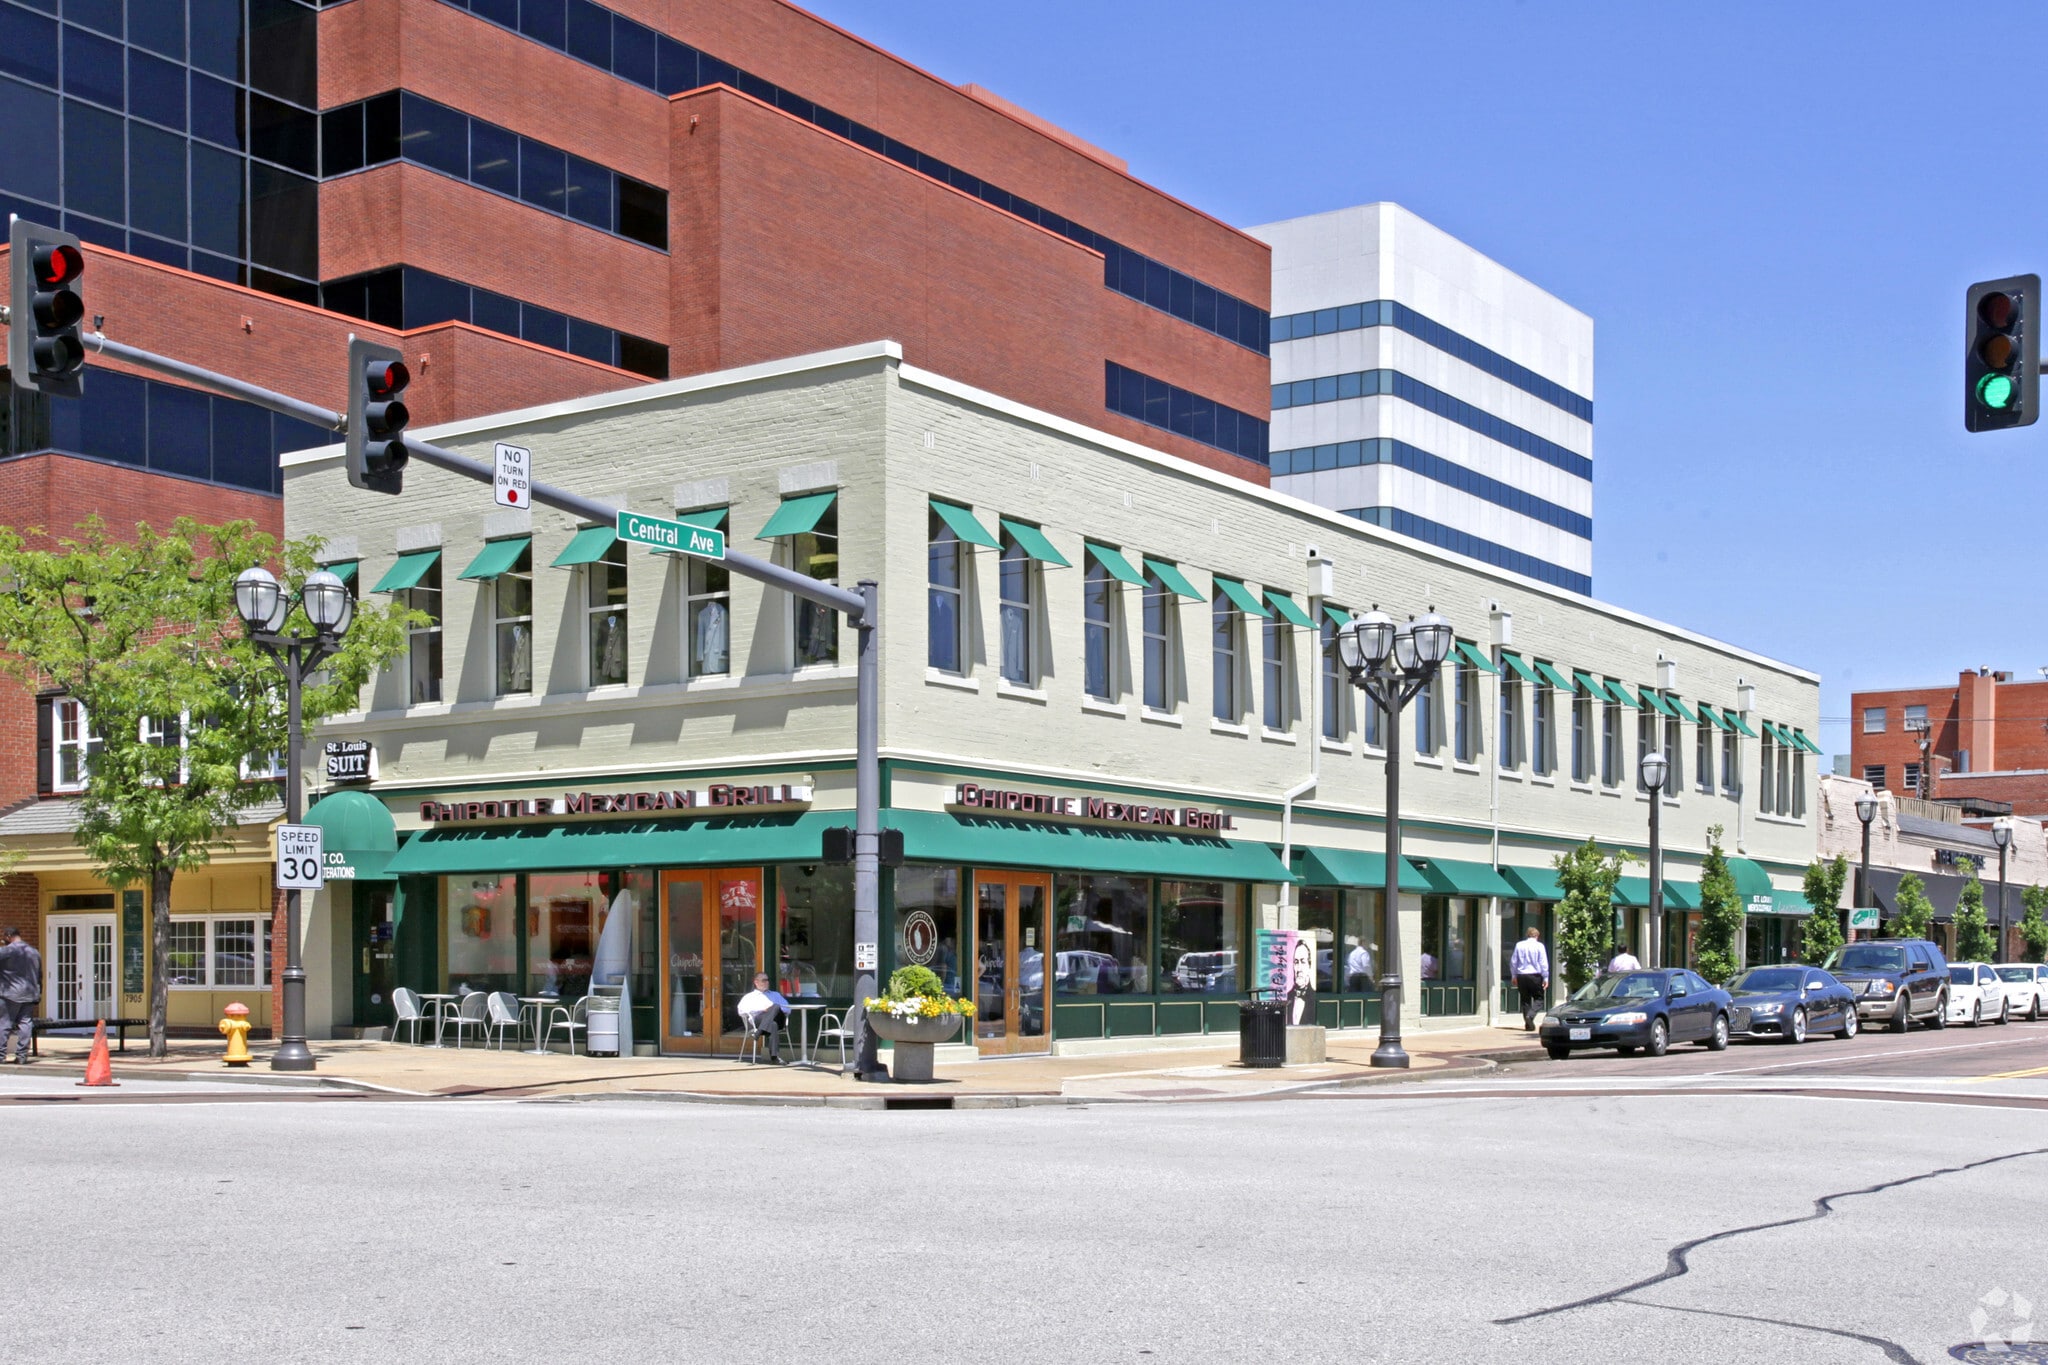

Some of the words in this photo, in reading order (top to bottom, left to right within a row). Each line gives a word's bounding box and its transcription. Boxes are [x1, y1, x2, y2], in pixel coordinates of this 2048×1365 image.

[504, 449, 522, 464] NO
[502, 464, 524, 476] TURN
[497, 476, 509, 486] ON
[512, 478, 528, 490] RED
[628, 518, 679, 546] Central
[689, 531, 715, 553] Ave
[326, 742, 340, 753] St.
[341, 740, 367, 753] Louis
[328, 754, 366, 774] SUIT
[420, 799, 554, 822] CHIPOTLE
[564, 789, 697, 815] MEXICAN
[708, 783, 802, 807] GRILL
[962, 783, 1077, 816] CHIPOTLE
[1086, 796, 1177, 826] MEXICAN
[1185, 807, 1239, 831] GRILL
[281, 831, 319, 843] SPEED
[285, 845, 315, 855] LIMIT
[329, 852, 346, 865] CO.
[283, 857, 318, 880] 30
